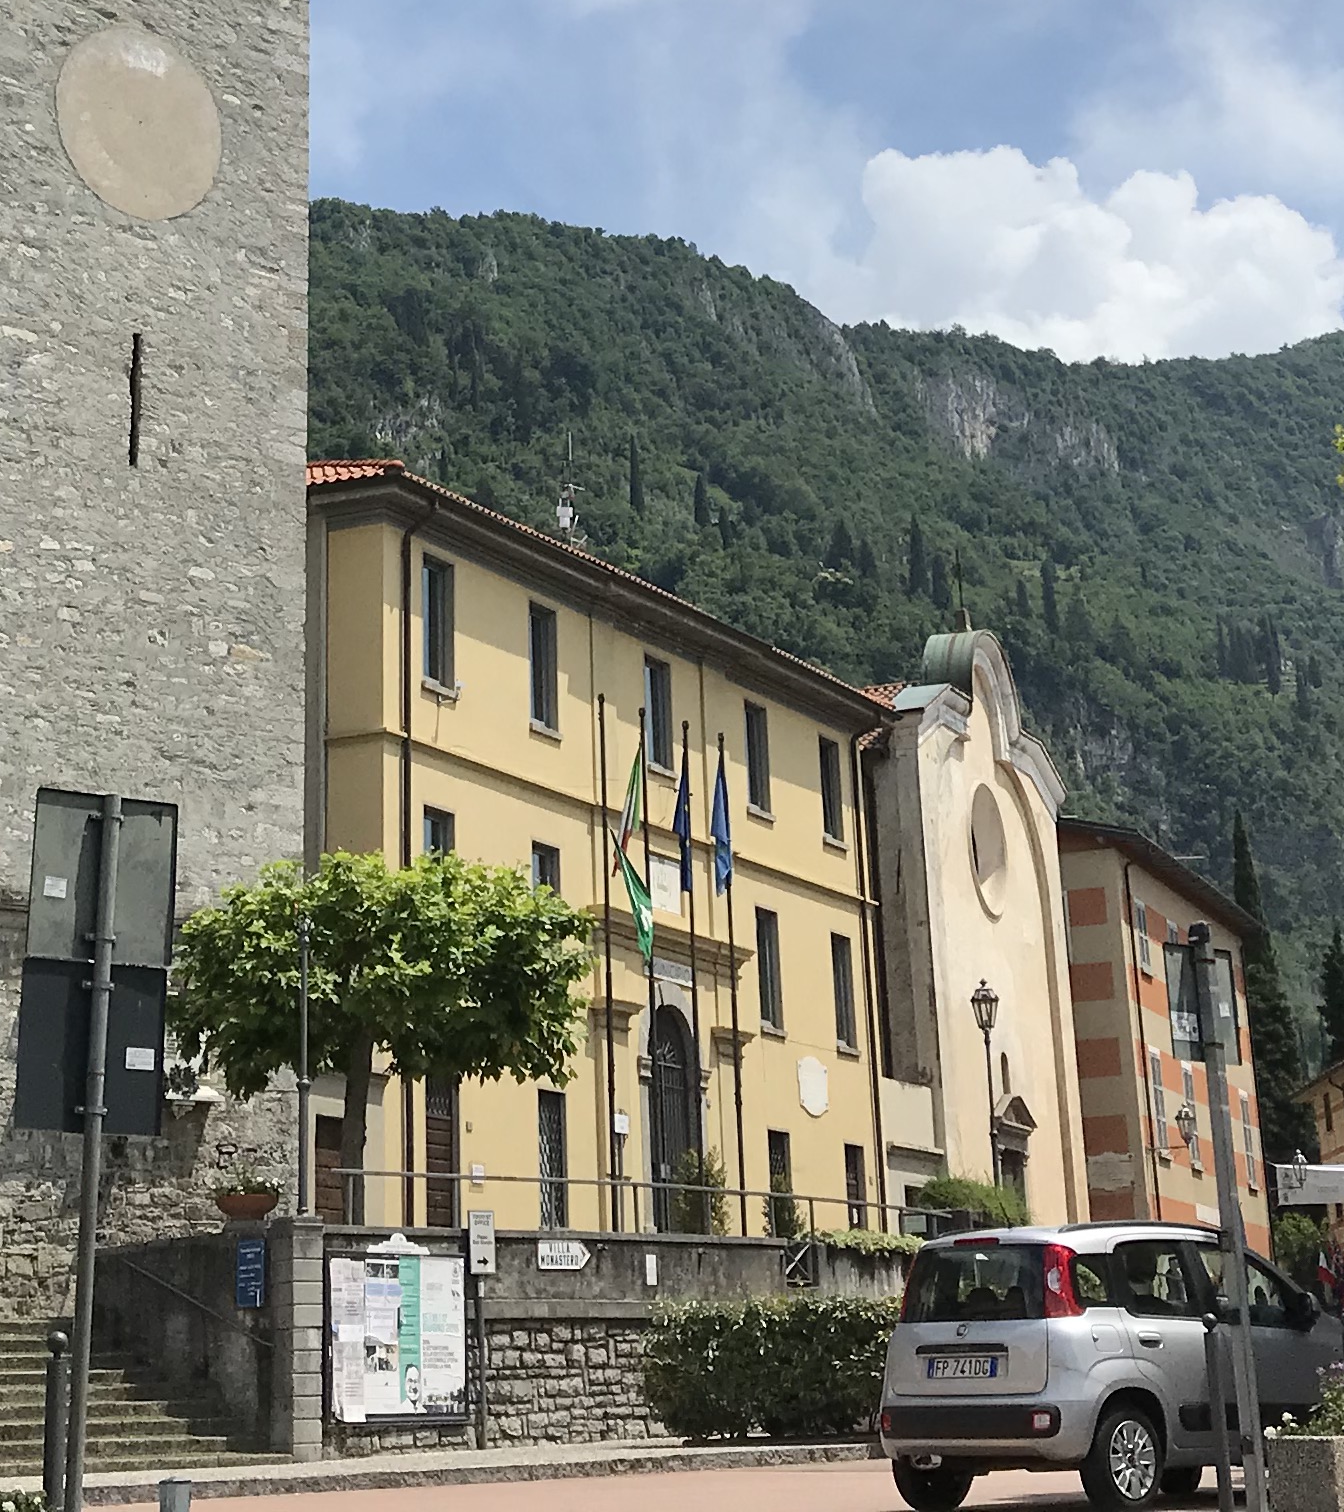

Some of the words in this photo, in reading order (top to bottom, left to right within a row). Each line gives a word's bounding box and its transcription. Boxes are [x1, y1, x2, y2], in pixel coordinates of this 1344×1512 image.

[549, 1242, 570, 1253] VILLA
[540, 1255, 579, 1267] MONASTERO
[935, 1360, 949, 1377] FP
[952, 1358, 989, 1376] 741DG
